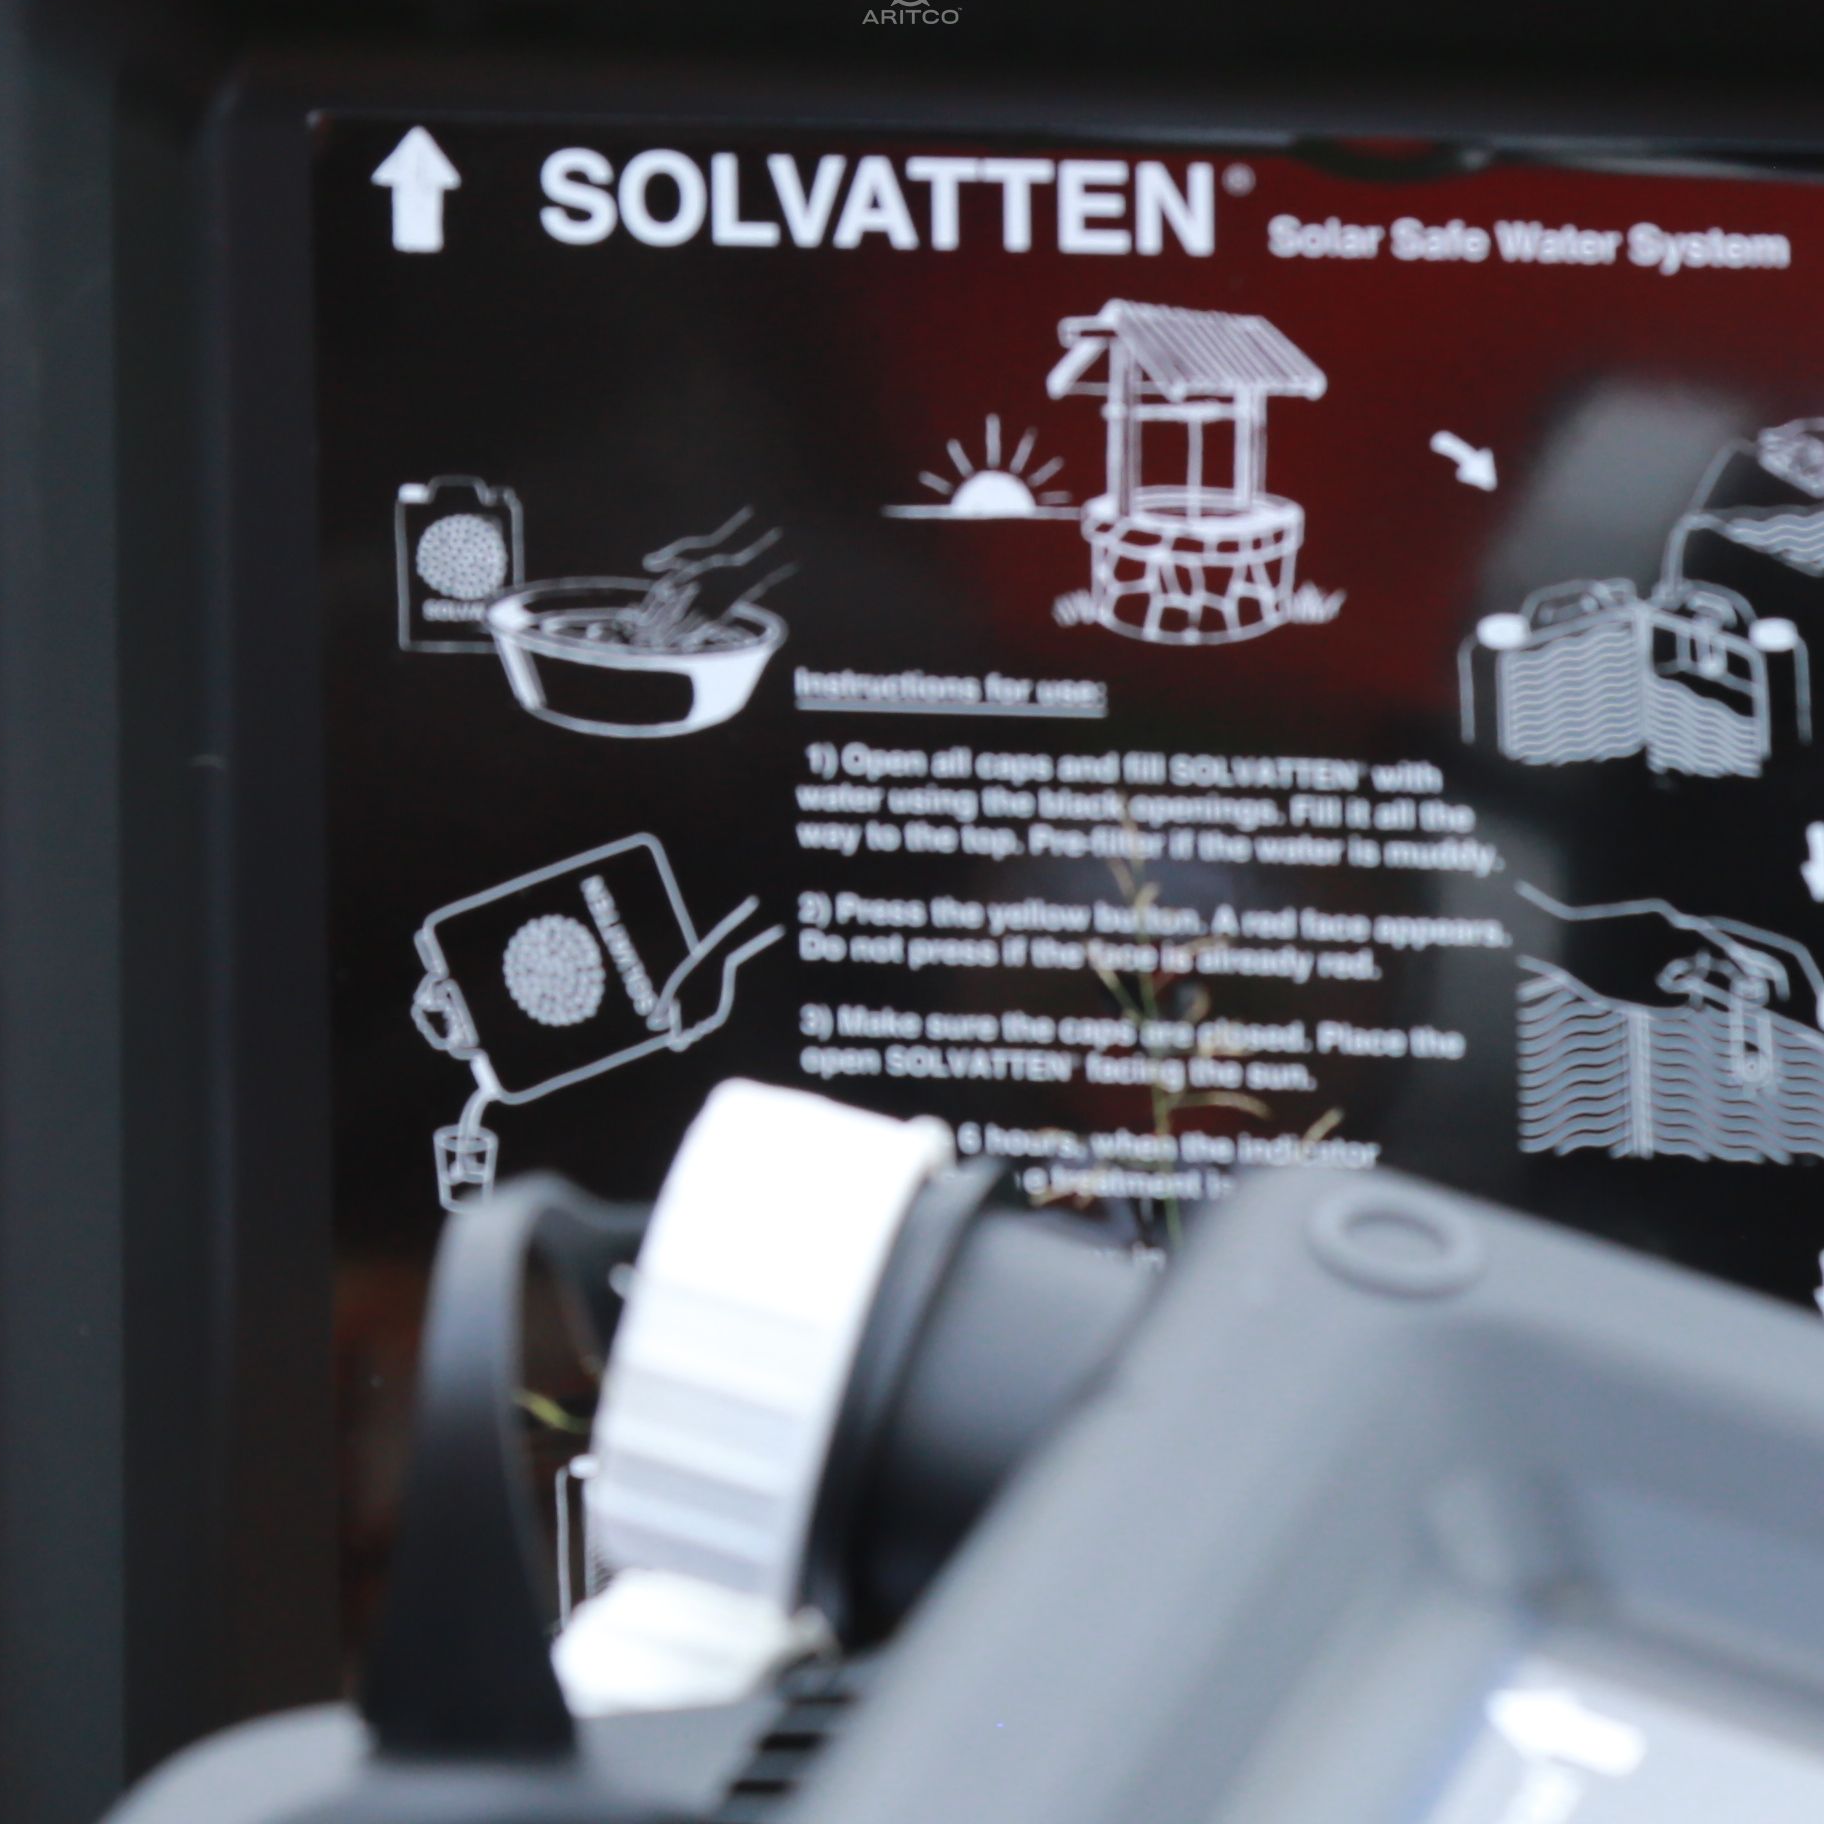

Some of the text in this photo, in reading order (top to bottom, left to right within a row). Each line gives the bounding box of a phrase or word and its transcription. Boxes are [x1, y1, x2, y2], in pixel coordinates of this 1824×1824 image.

[1267, 214, 1385, 260] Solar
[1390, 217, 1491, 263] Safe
[1494, 219, 1623, 265] Water
[1626, 222, 1793, 276] System
[794, 665, 1108, 708] Instructions for use:
[806, 741, 838, 780] 1)
[841, 741, 928, 782] Open
[931, 745, 973, 779] all
[975, 752, 1055, 787] caps
[1057, 750, 1120, 784] and
[1123, 750, 1167, 785] fill
[1372, 759, 1443, 794] with
[795, 782, 1475, 833] water using the black openings. Fill it all the
[795, 821, 862, 857] way
[866, 819, 902, 852] to
[904, 820, 959, 854] the
[961, 823, 1025, 862] top.
[1168, 826, 1195, 861] if
[1197, 829, 1252, 864] the
[1254, 833, 1345, 866] water
[1347, 834, 1381, 868] is
[1383, 837, 1505, 878] muddy.
[797, 890, 832, 929] 2)
[835, 890, 927, 927] Press
[930, 895, 985, 929] the
[987, 897, 1092, 936] yellow
[1210, 903, 1239, 938] A
[1241, 906, 1298, 941] red
[1300, 907, 1372, 943] face
[1374, 914, 1514, 951] appears.
[798, 927, 1383, 984] Do not press if the face is already red.
[799, 1003, 834, 1042] 3)
[837, 1003, 923, 1040] Make
[926, 1012, 999, 1043] sure
[1001, 1009, 1056, 1044] the
[1058, 1016, 1138, 1053] caps
[1140, 1019, 1195, 1049] are
[1316, 1019, 1408, 1058] Place
[1409, 1024, 1467, 1059] the
[800, 1045, 882, 1080] open
[1085, 1050, 1186, 1093] facing
[1188, 1057, 1243, 1089] the
[1246, 1062, 1318, 1092] sun.
[1090, 1127, 1177, 1163] when
[1179, 1128, 1236, 1164] the
